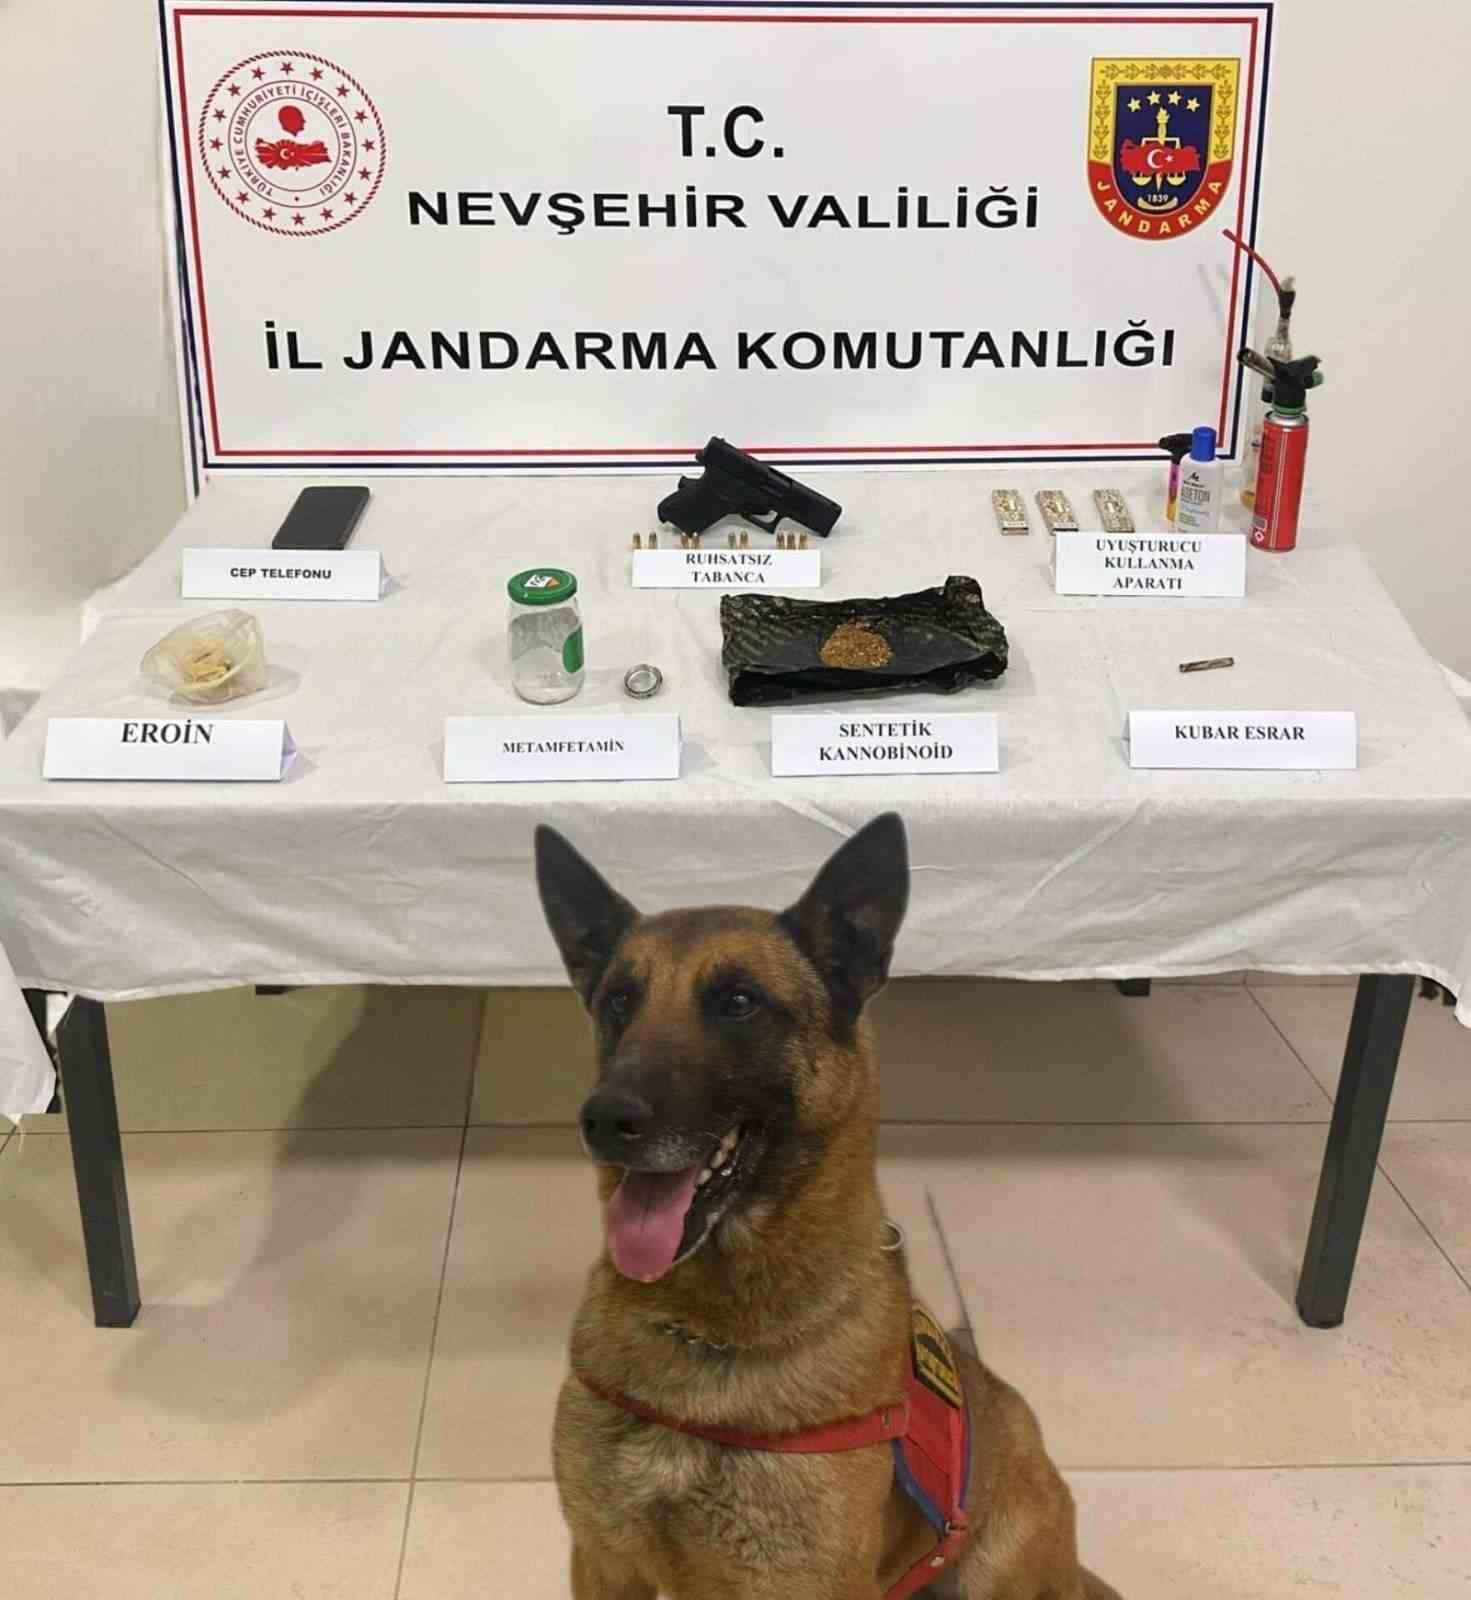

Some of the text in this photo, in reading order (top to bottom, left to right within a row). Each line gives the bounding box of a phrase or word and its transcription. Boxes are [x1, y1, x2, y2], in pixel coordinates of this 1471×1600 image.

[667, 105, 785, 158] T.C.
[233, 85, 297, 144] CUMHURİYETİ
[319, 131, 353, 197] BAKANLIĞI
[408, 185, 1039, 236] NEVŞEHİR VALİLİĞİ
[1096, 180, 1223, 234] JANDARMA
[264, 319, 1176, 370] İL JANDARMA KOMUTANLIĞI
[1096, 539, 1202, 554] UYUŞTURUCU
[685, 552, 774, 566] RUHSATSIZ
[1105, 556, 1195, 570] KULLANMA
[230, 567, 332, 579] CEP TELEFONU
[691, 570, 766, 583] TABANCA
[1112, 577, 1183, 590] APARATI
[121, 718, 214, 744] EROİN
[839, 719, 932, 738] SENTETİK
[1175, 725, 1306, 741] KUBAR ESRAR
[502, 737, 625, 753] METAMFETAMİN
[819, 742, 953, 761] KANNOBİNOİD
